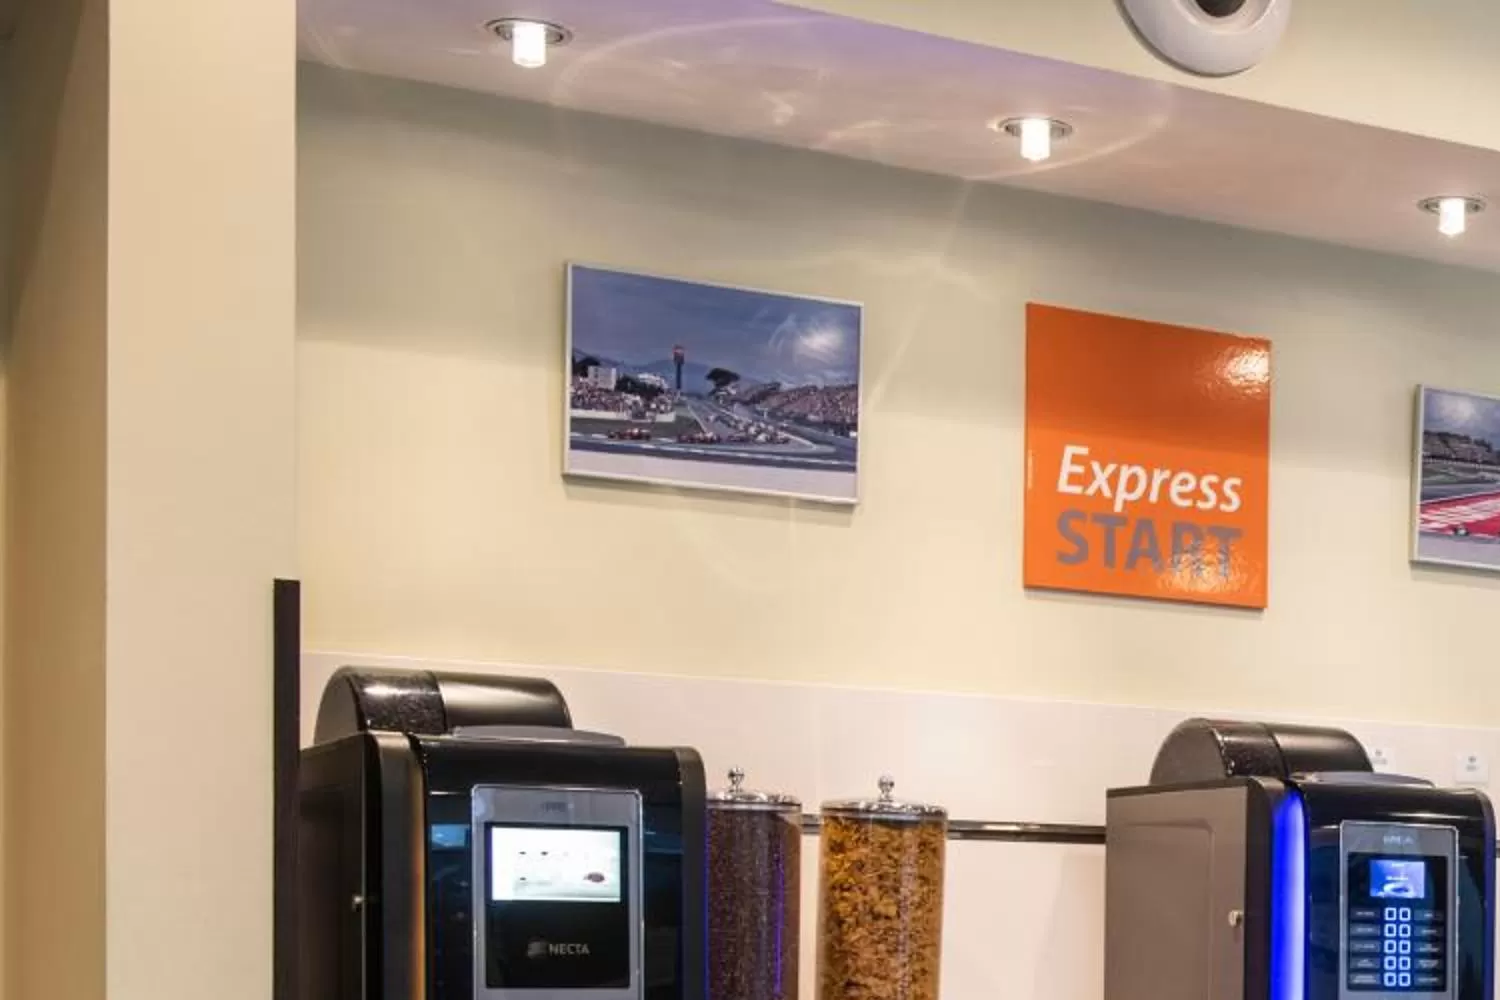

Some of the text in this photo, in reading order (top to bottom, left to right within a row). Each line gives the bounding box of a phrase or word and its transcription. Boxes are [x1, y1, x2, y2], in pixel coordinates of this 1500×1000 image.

[1057, 445, 1243, 513] Express
[1056, 508, 1244, 579] START
[549, 943, 591, 956] NECTA
